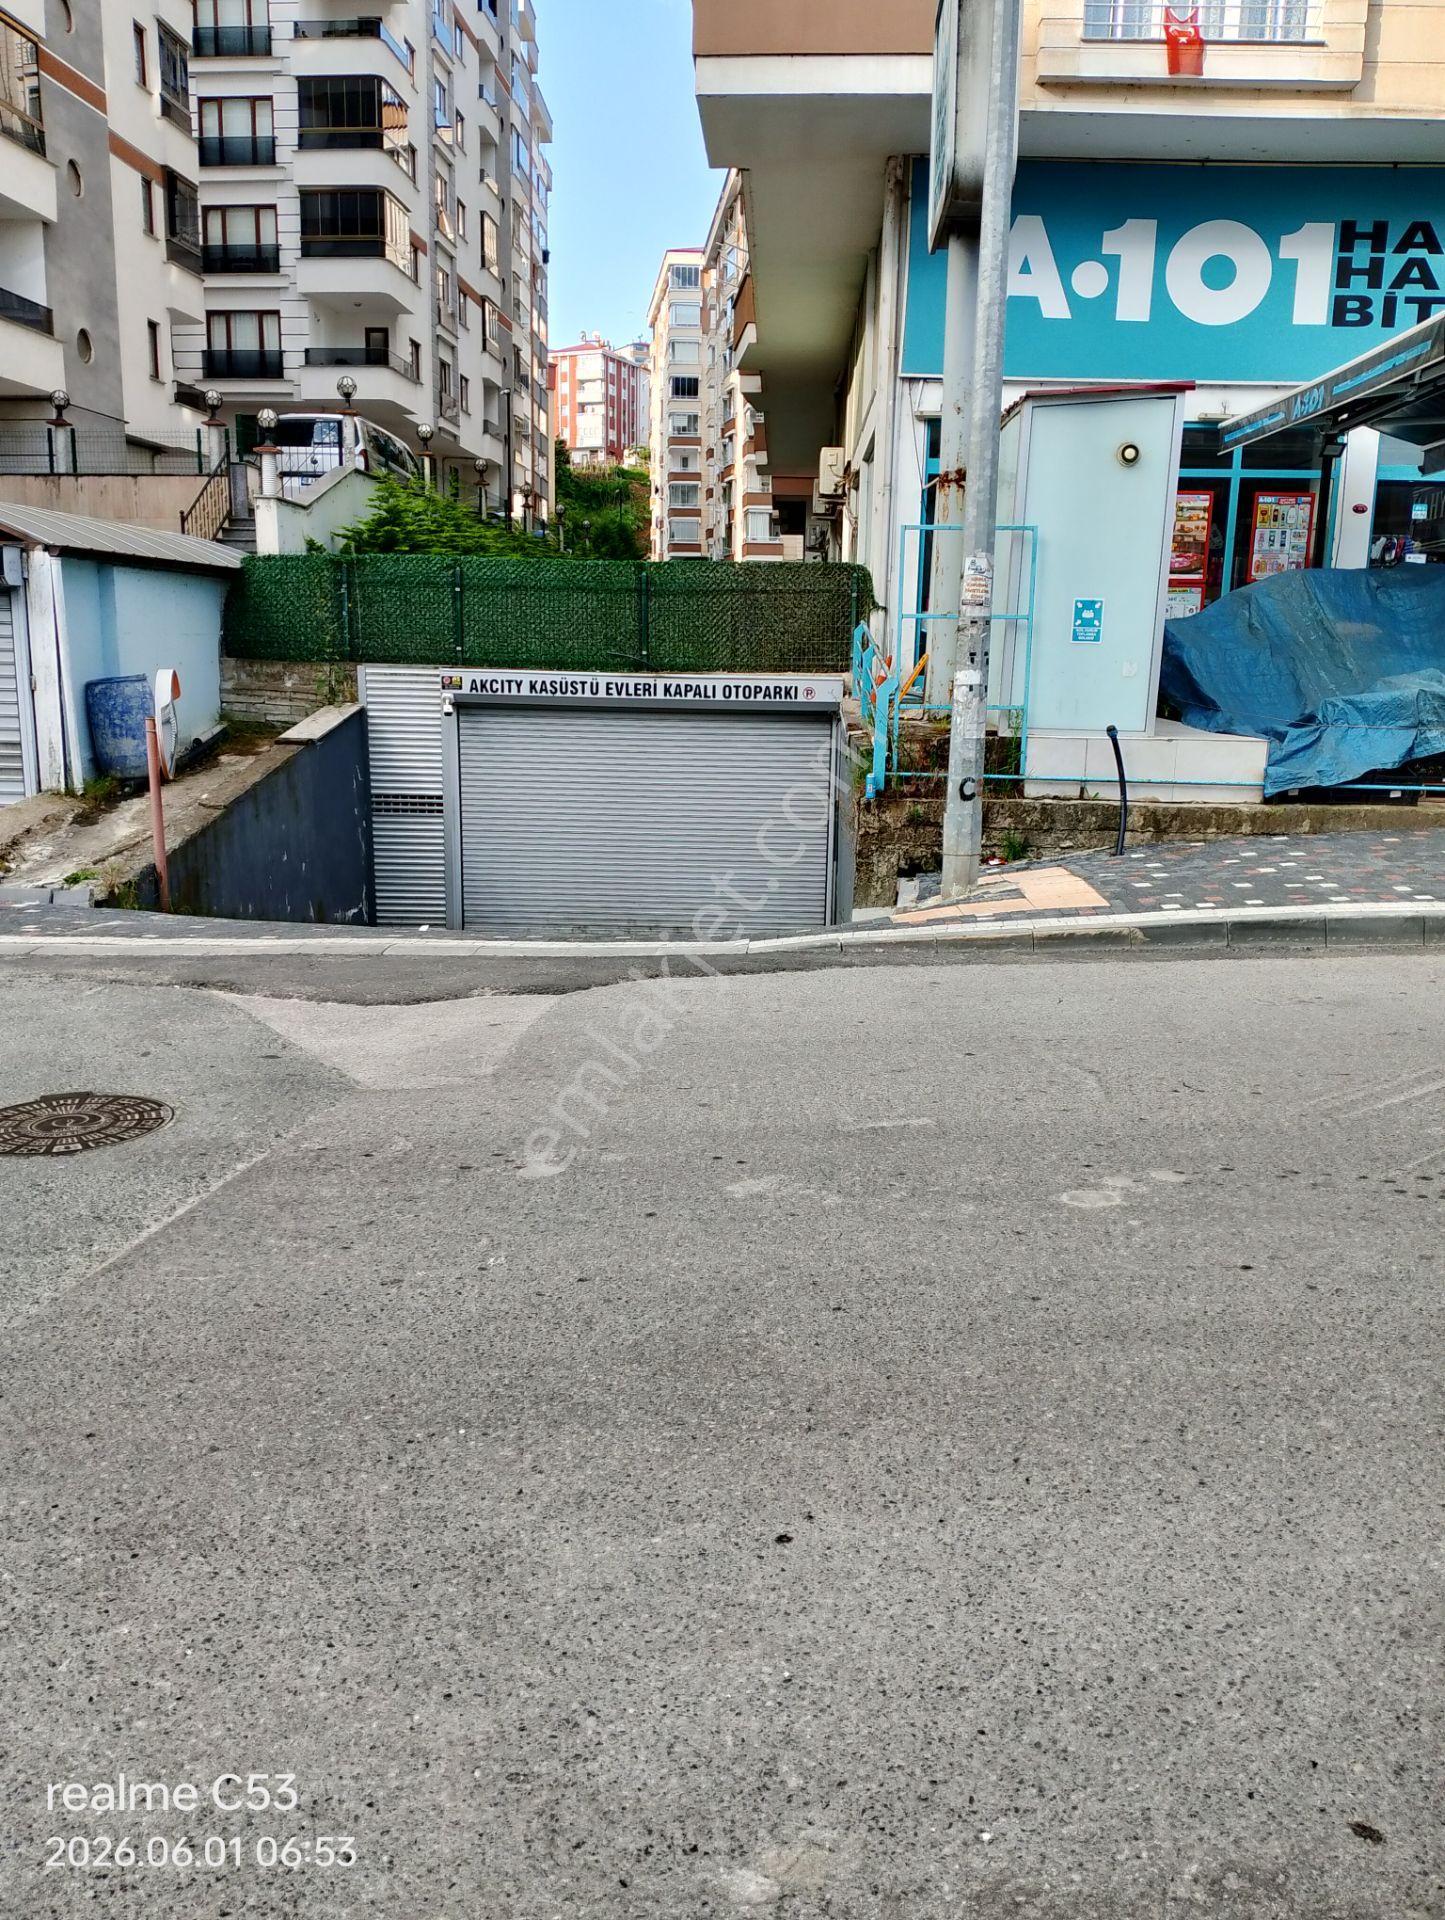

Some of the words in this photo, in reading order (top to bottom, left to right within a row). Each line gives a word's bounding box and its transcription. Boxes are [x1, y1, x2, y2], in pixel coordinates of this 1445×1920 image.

[469, 679, 524, 694] AKCITY
[605, 679, 657, 697] EVLERİ
[663, 683, 717, 699] KAPALI
[722, 684, 799, 700] OTOPARKI
